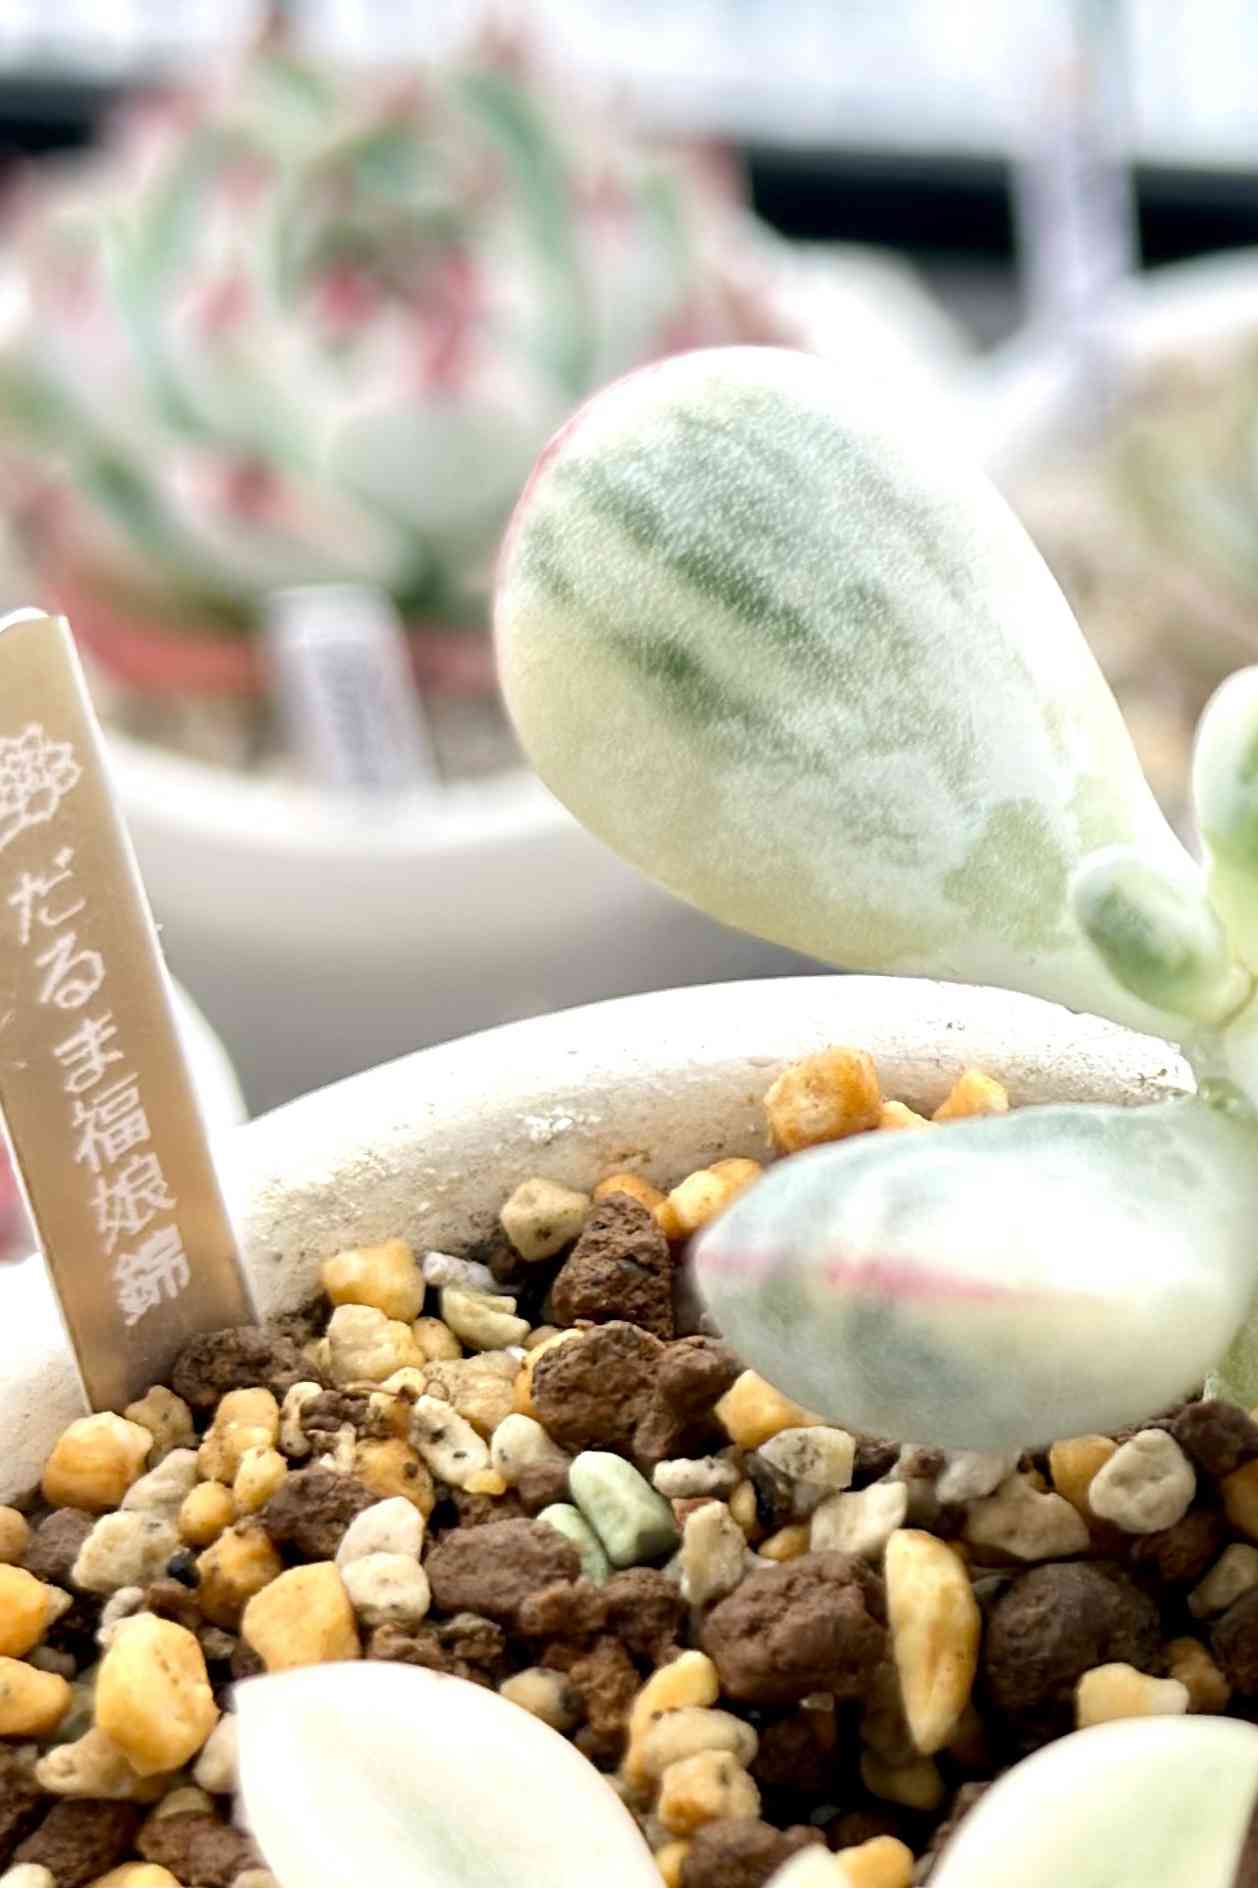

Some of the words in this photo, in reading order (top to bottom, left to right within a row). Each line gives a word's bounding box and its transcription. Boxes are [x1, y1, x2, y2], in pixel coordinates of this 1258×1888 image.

[8, 847, 191, 1327] だるま福娘錦
